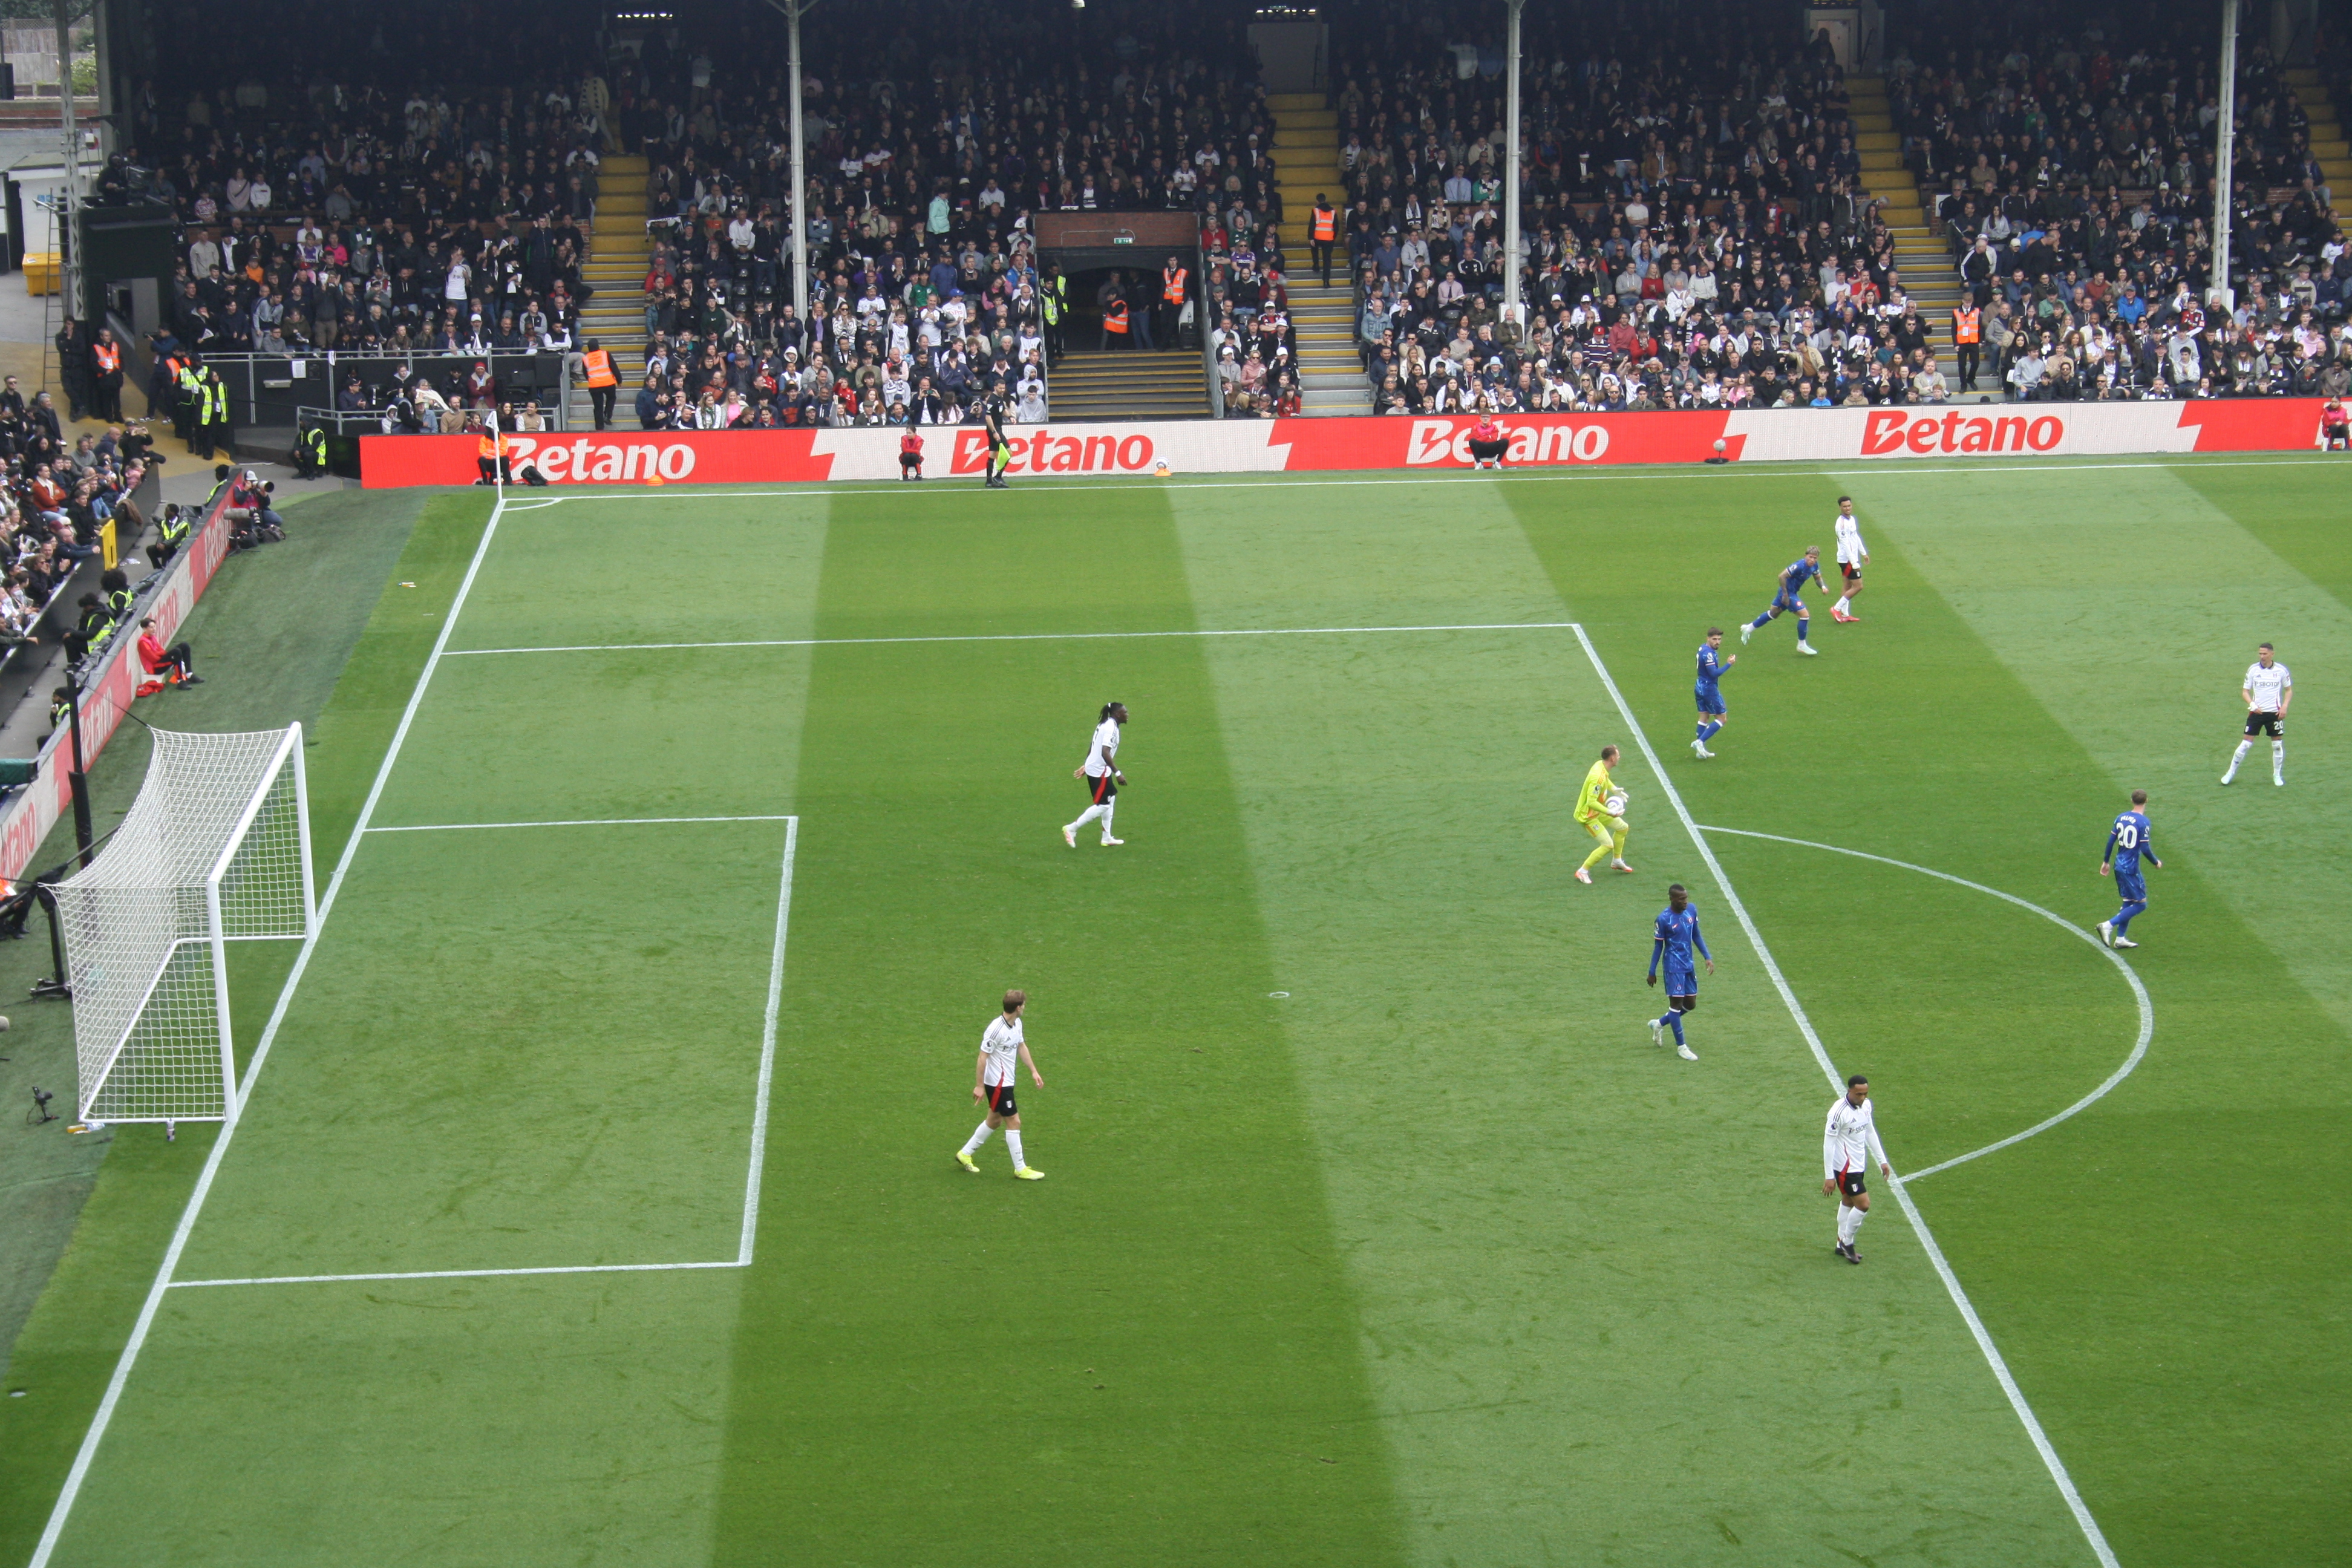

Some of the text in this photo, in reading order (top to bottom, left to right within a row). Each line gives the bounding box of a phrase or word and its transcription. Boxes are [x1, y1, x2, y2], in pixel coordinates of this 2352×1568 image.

[950, 430, 1153, 474] Betano
[1861, 411, 2063, 455] Betano
[508, 437, 696, 482] Betano
[204, 505, 232, 578] Betan
[149, 588, 177, 648] tano
[2274, 720, 2284, 730] 20
[2116, 822, 2137, 849] 20
